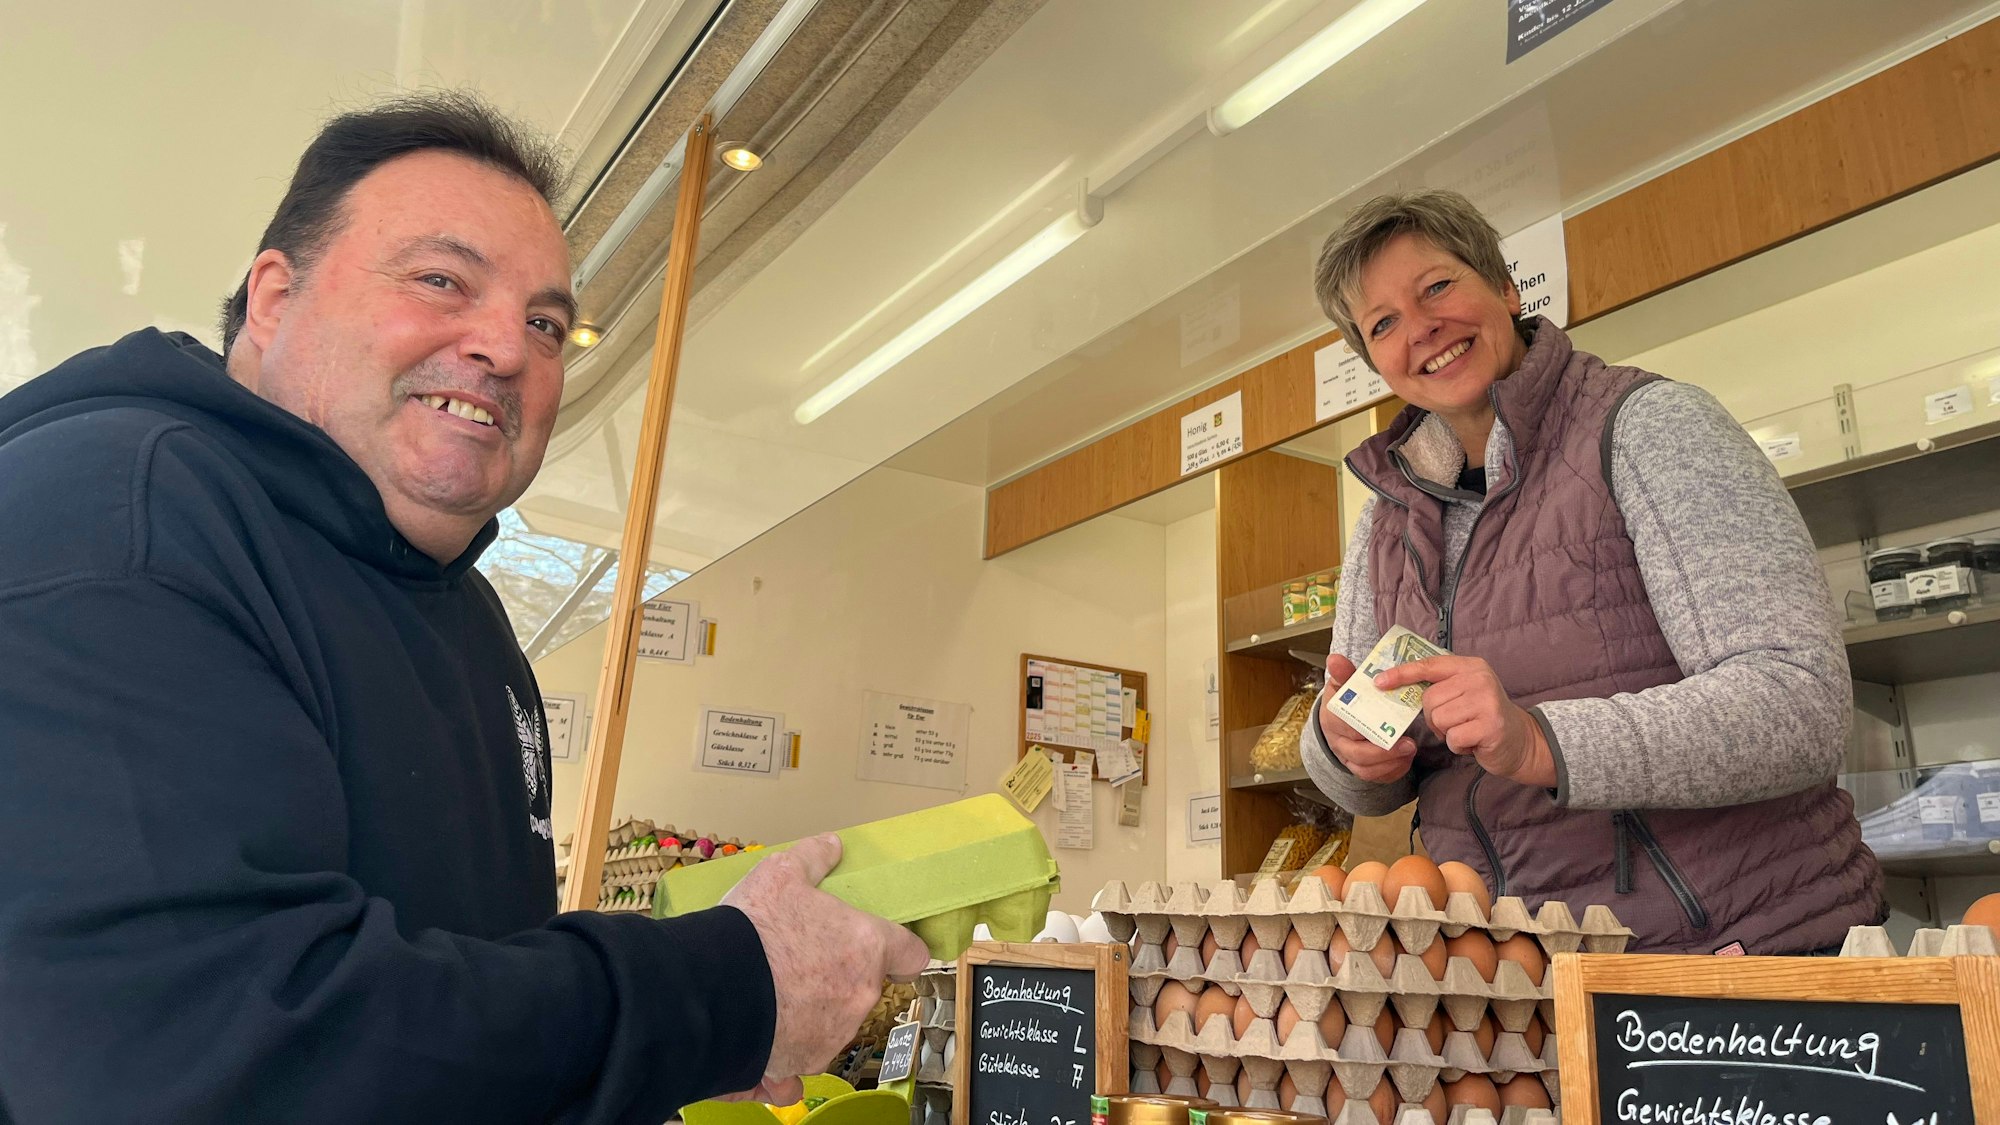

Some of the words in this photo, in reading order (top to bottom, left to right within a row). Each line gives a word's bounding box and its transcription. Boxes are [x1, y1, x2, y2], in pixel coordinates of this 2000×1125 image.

[1517, 22, 1544, 41] Kinder
[1520, 295, 1551, 318] Euro
[1187, 421, 1207, 437] Honig
[1401, 687, 1415, 703] EURO
[720, 715, 763, 727] Bodenhaltung
[713, 729, 759, 741] Gewichtsklasse
[1026, 731, 1041, 741] 2025
[1380, 722, 1396, 738] 5
[711, 743, 745, 753] Güteklasse
[717, 759, 735, 767] Stück
[983, 976, 1071, 1013] Bodenhaltung
[980, 1018, 1059, 1043] Gewichtsklasse
[1074, 1025, 1087, 1054] L
[1616, 1009, 1880, 1077] Bodenhaltung
[978, 1053, 1041, 1079] Güteklasse
[1617, 1088, 1831, 1125] Gewichtsklasse
